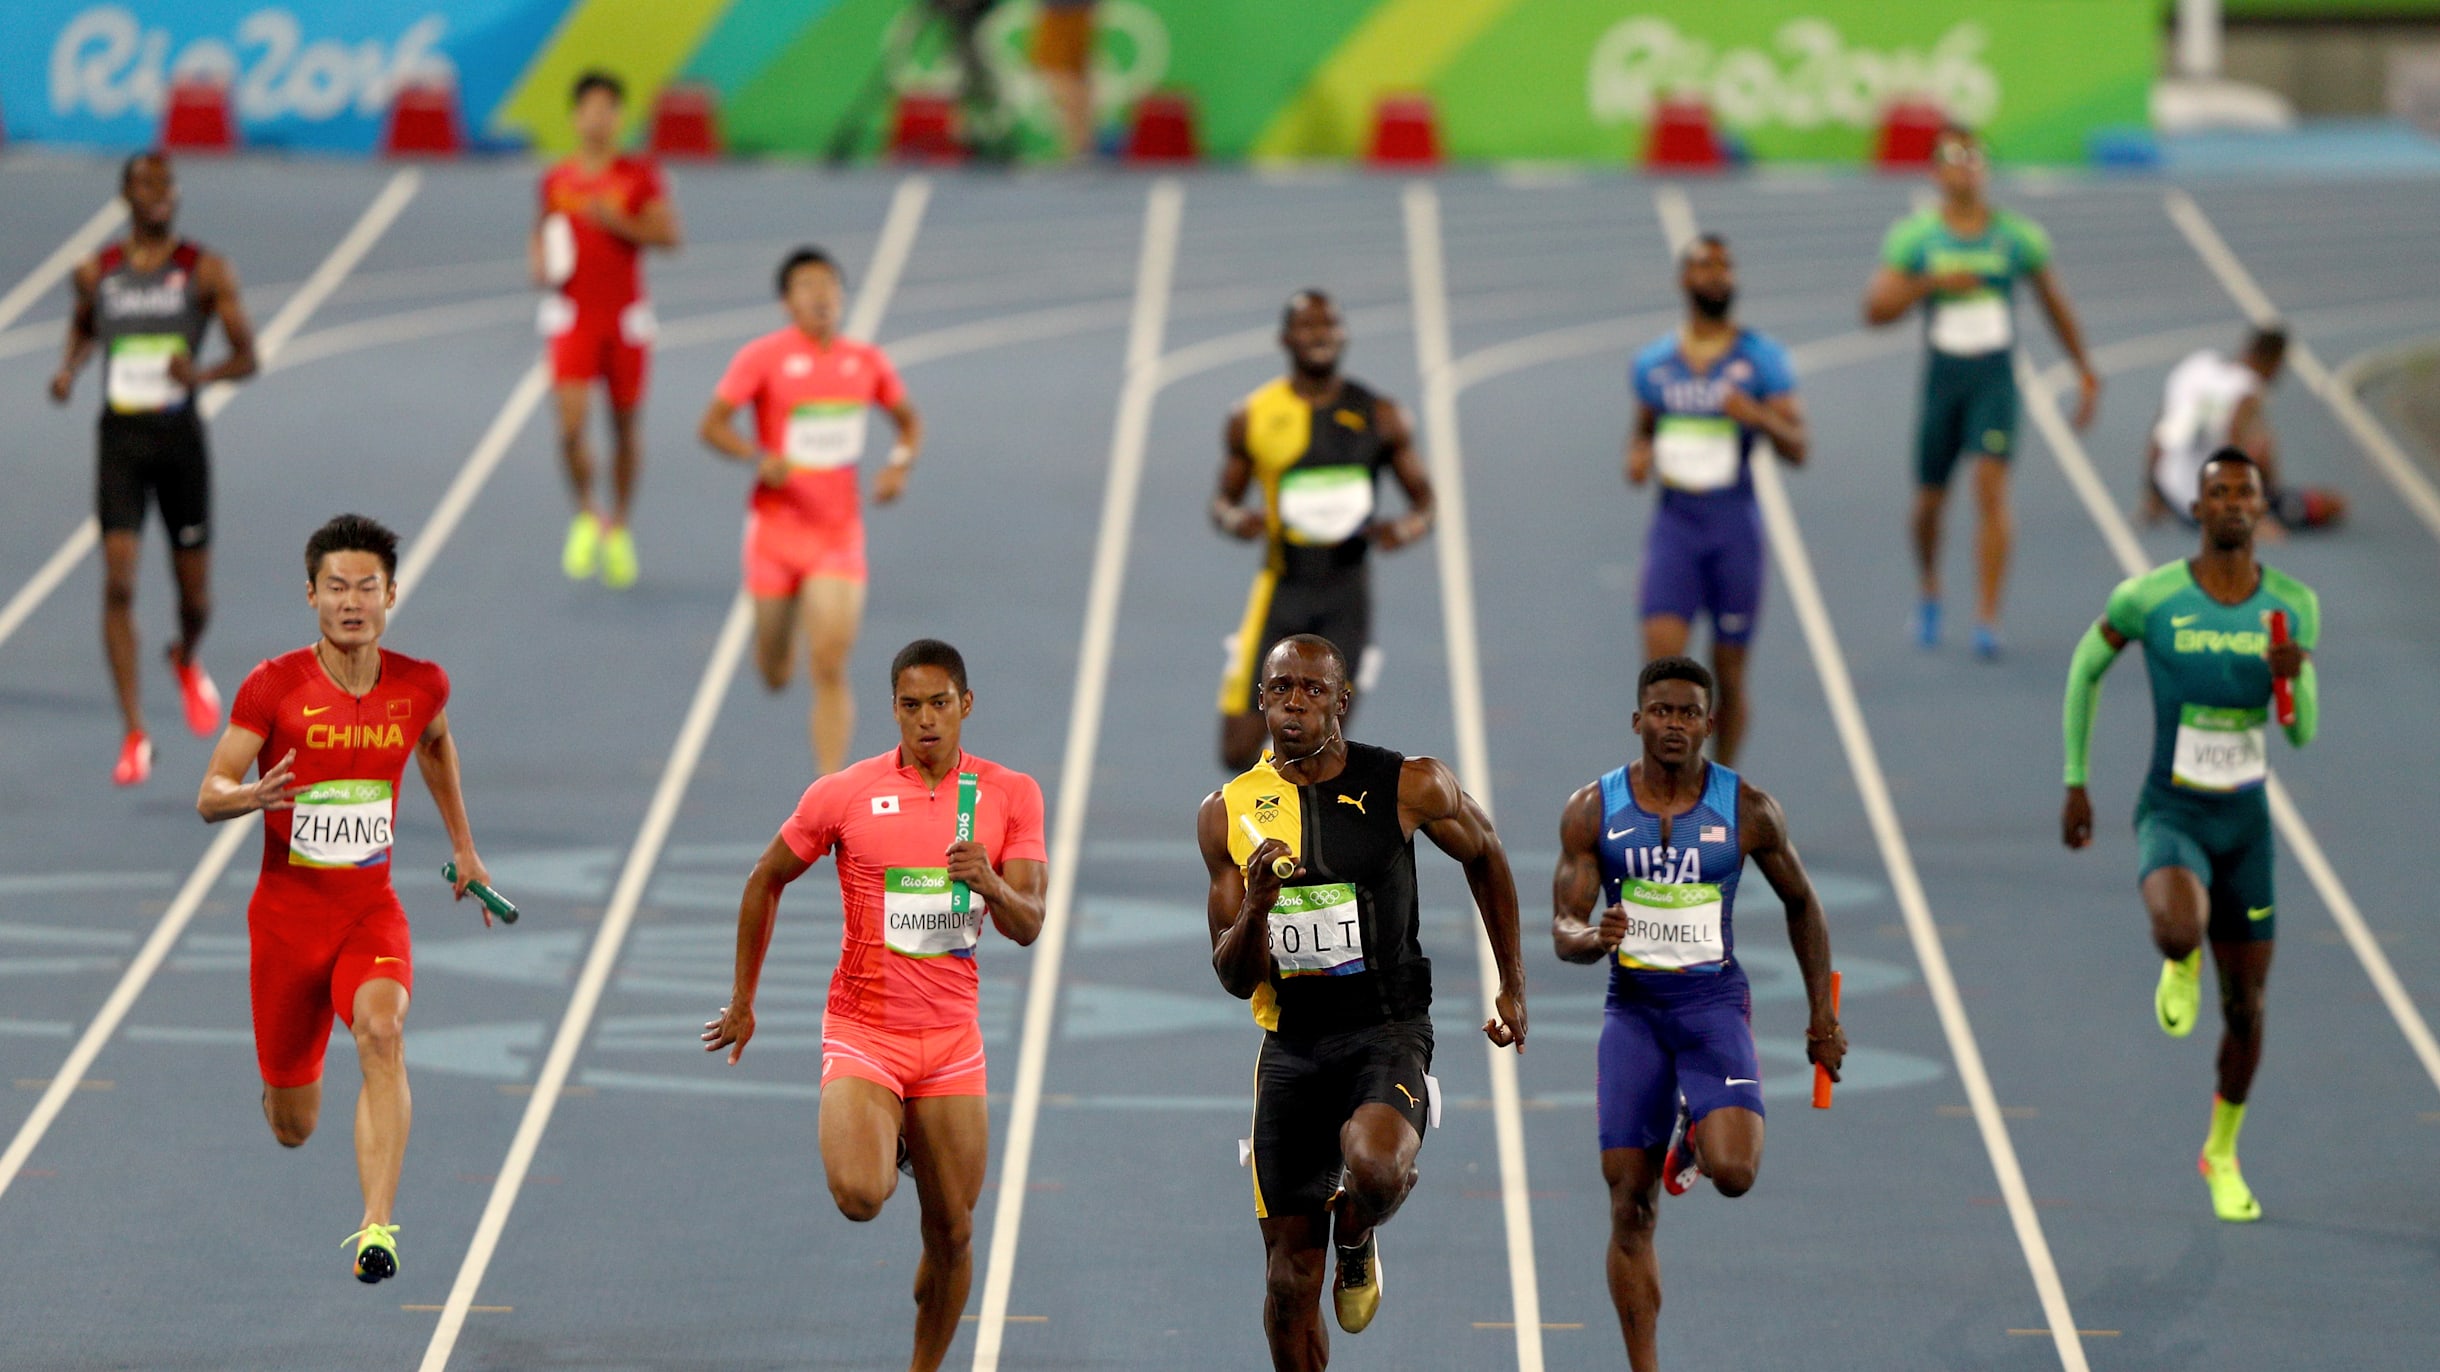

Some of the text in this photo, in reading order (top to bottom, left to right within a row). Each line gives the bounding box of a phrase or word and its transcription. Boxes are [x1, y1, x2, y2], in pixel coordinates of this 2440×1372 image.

[2174, 629, 2269, 655] BRASI
[305, 723, 405, 749] CHINA
[294, 814, 389, 844] ZHANG
[1625, 845, 1700, 885] USA
[901, 875, 945, 888] Rio2016
[1633, 885, 1673, 903] Rio2016
[1626, 917, 1713, 943] BROMELL
